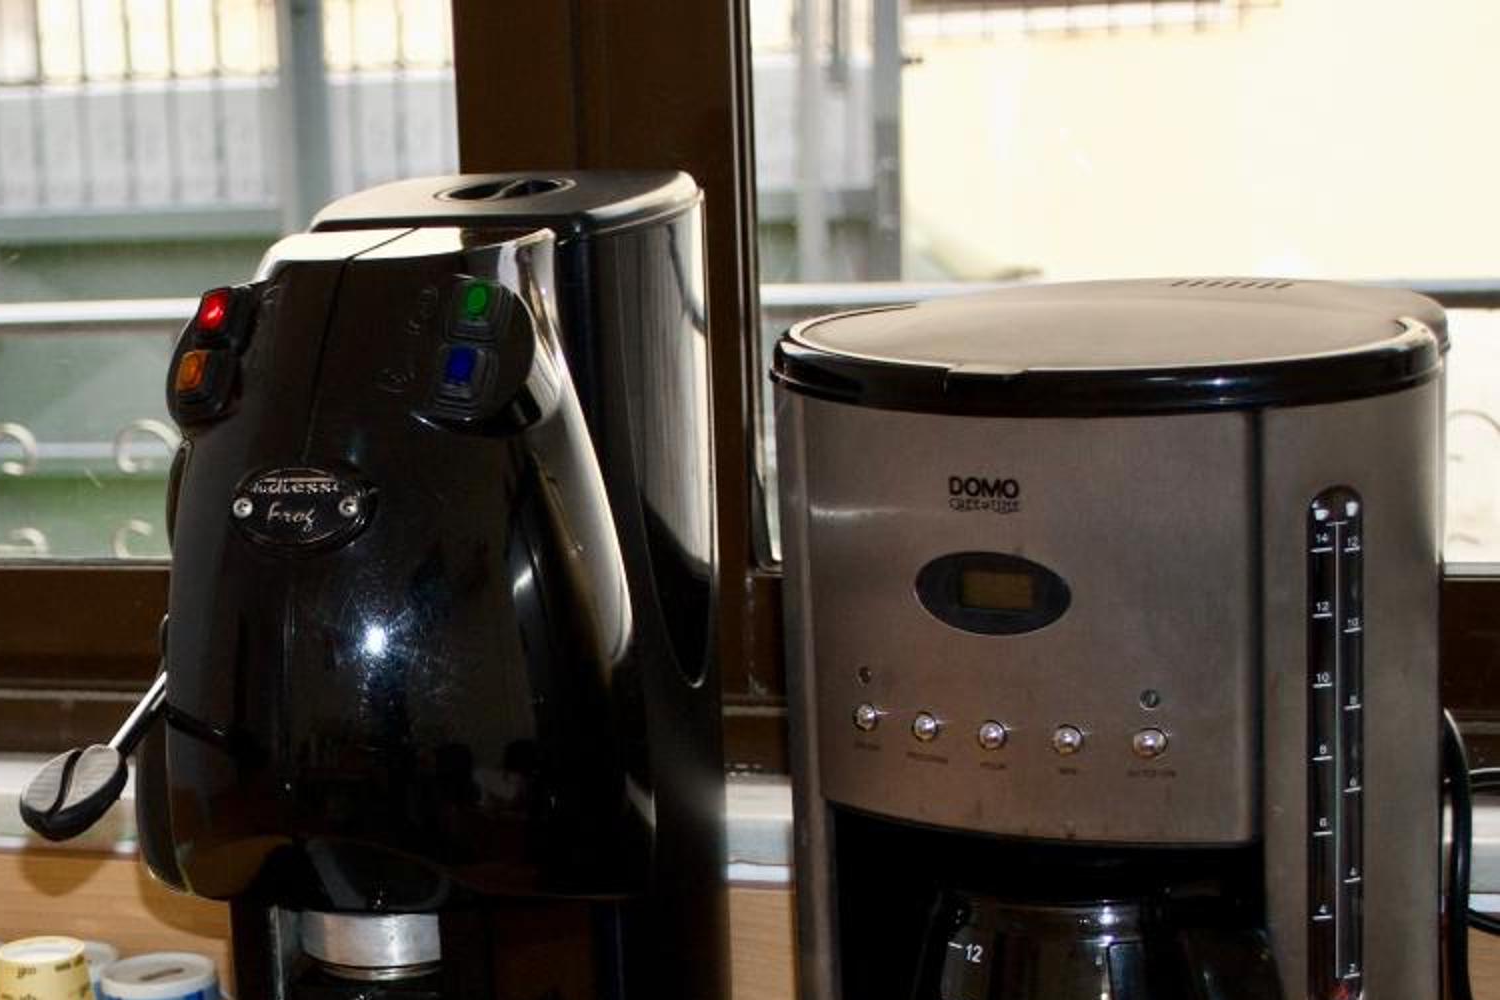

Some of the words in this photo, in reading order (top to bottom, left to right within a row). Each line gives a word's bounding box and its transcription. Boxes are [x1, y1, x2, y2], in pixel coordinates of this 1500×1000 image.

[948, 476, 1020, 498] DOMO
[267, 501, 316, 533] Frog
[1315, 532, 1329, 543] 14
[1315, 600, 1330, 611] 12
[1315, 672, 1330, 683] 10
[965, 943, 984, 963] 12
